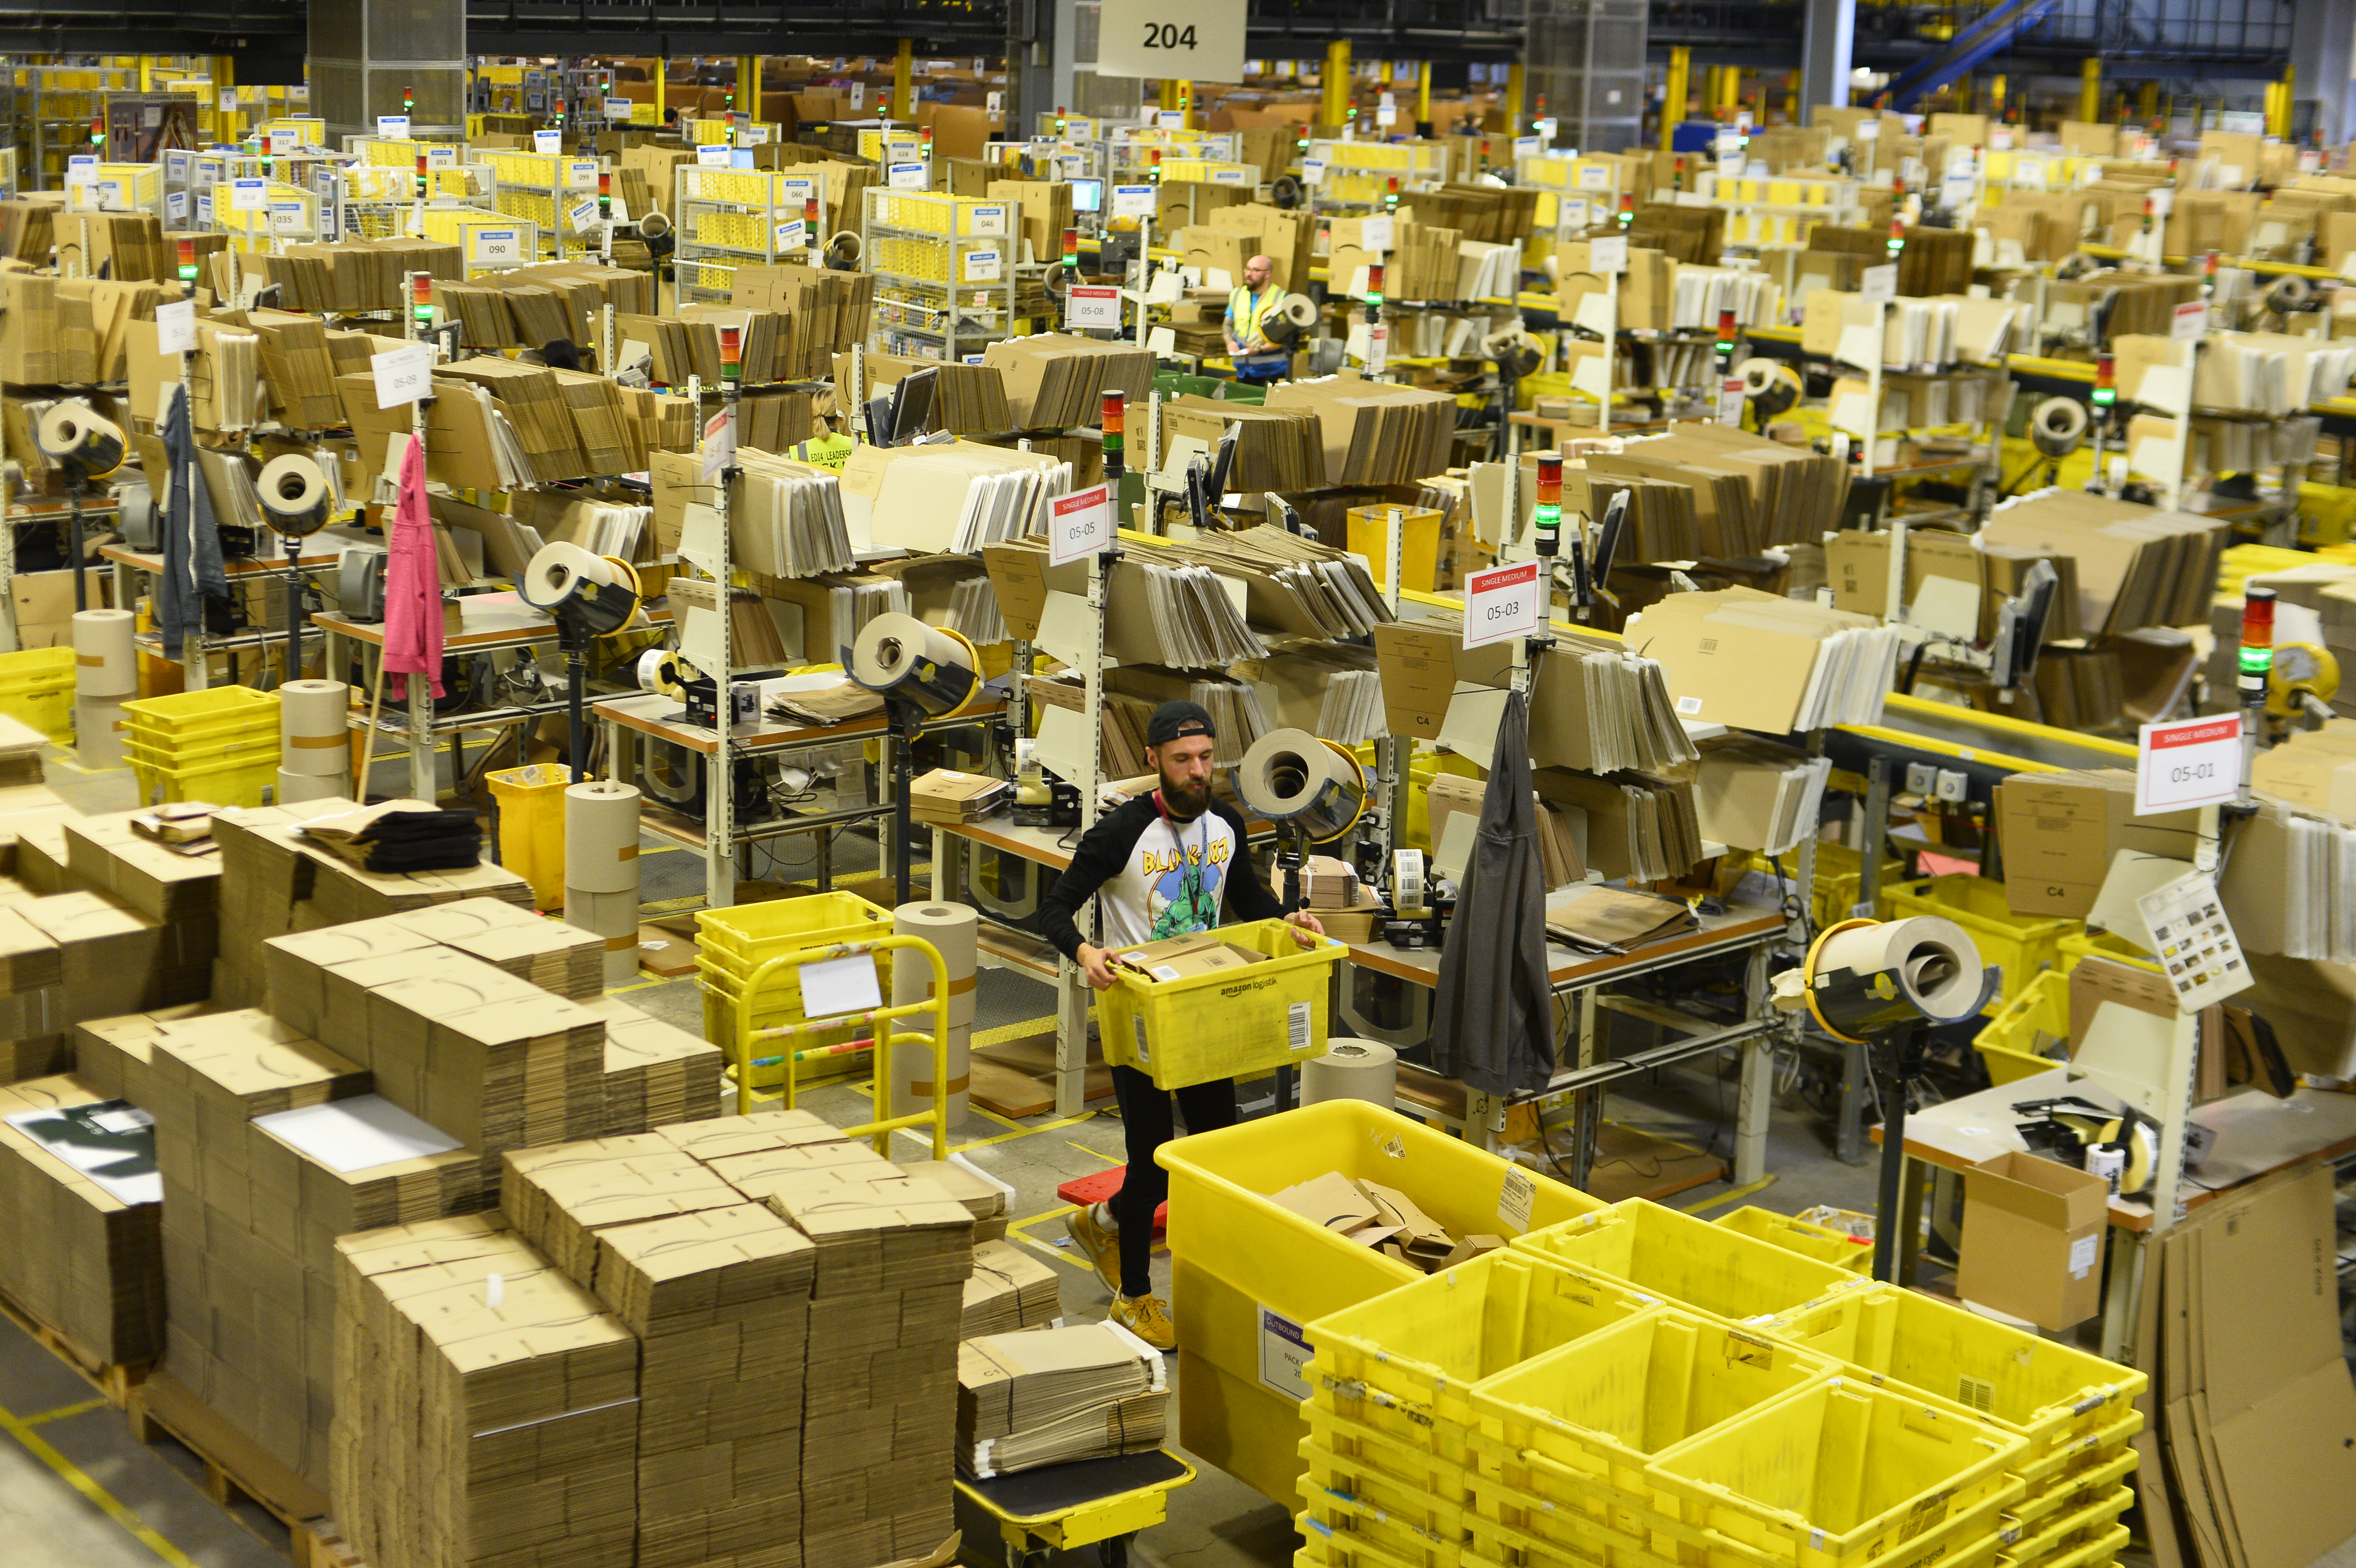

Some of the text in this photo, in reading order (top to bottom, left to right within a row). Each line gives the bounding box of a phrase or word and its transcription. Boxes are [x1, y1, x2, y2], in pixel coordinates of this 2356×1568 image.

[1144, 22, 1198, 49] 204
[276, 216, 292, 224] 035
[489, 245, 506, 253] 090
[1081, 307, 1104, 315] 05-08
[394, 374, 417, 388] 05-09
[1062, 494, 1101, 511] SINGLE MEDIUM
[1070, 522, 1095, 540] 05-05
[1481, 570, 1527, 588] SINGLE MEDIUM
[1487, 601, 1519, 621] 05-03
[1026, 622, 1036, 631] C4
[1416, 716, 1430, 726] C4
[2164, 726, 2228, 744] SINGLE MEDIUM
[2173, 763, 2215, 783] 05-01
[2047, 886, 2064, 897] C4
[1221, 977, 1278, 996] amazon logistik
[1267, 1318, 1300, 1339] OUTBOUND
[1285, 1353, 1300, 1367] PACK
